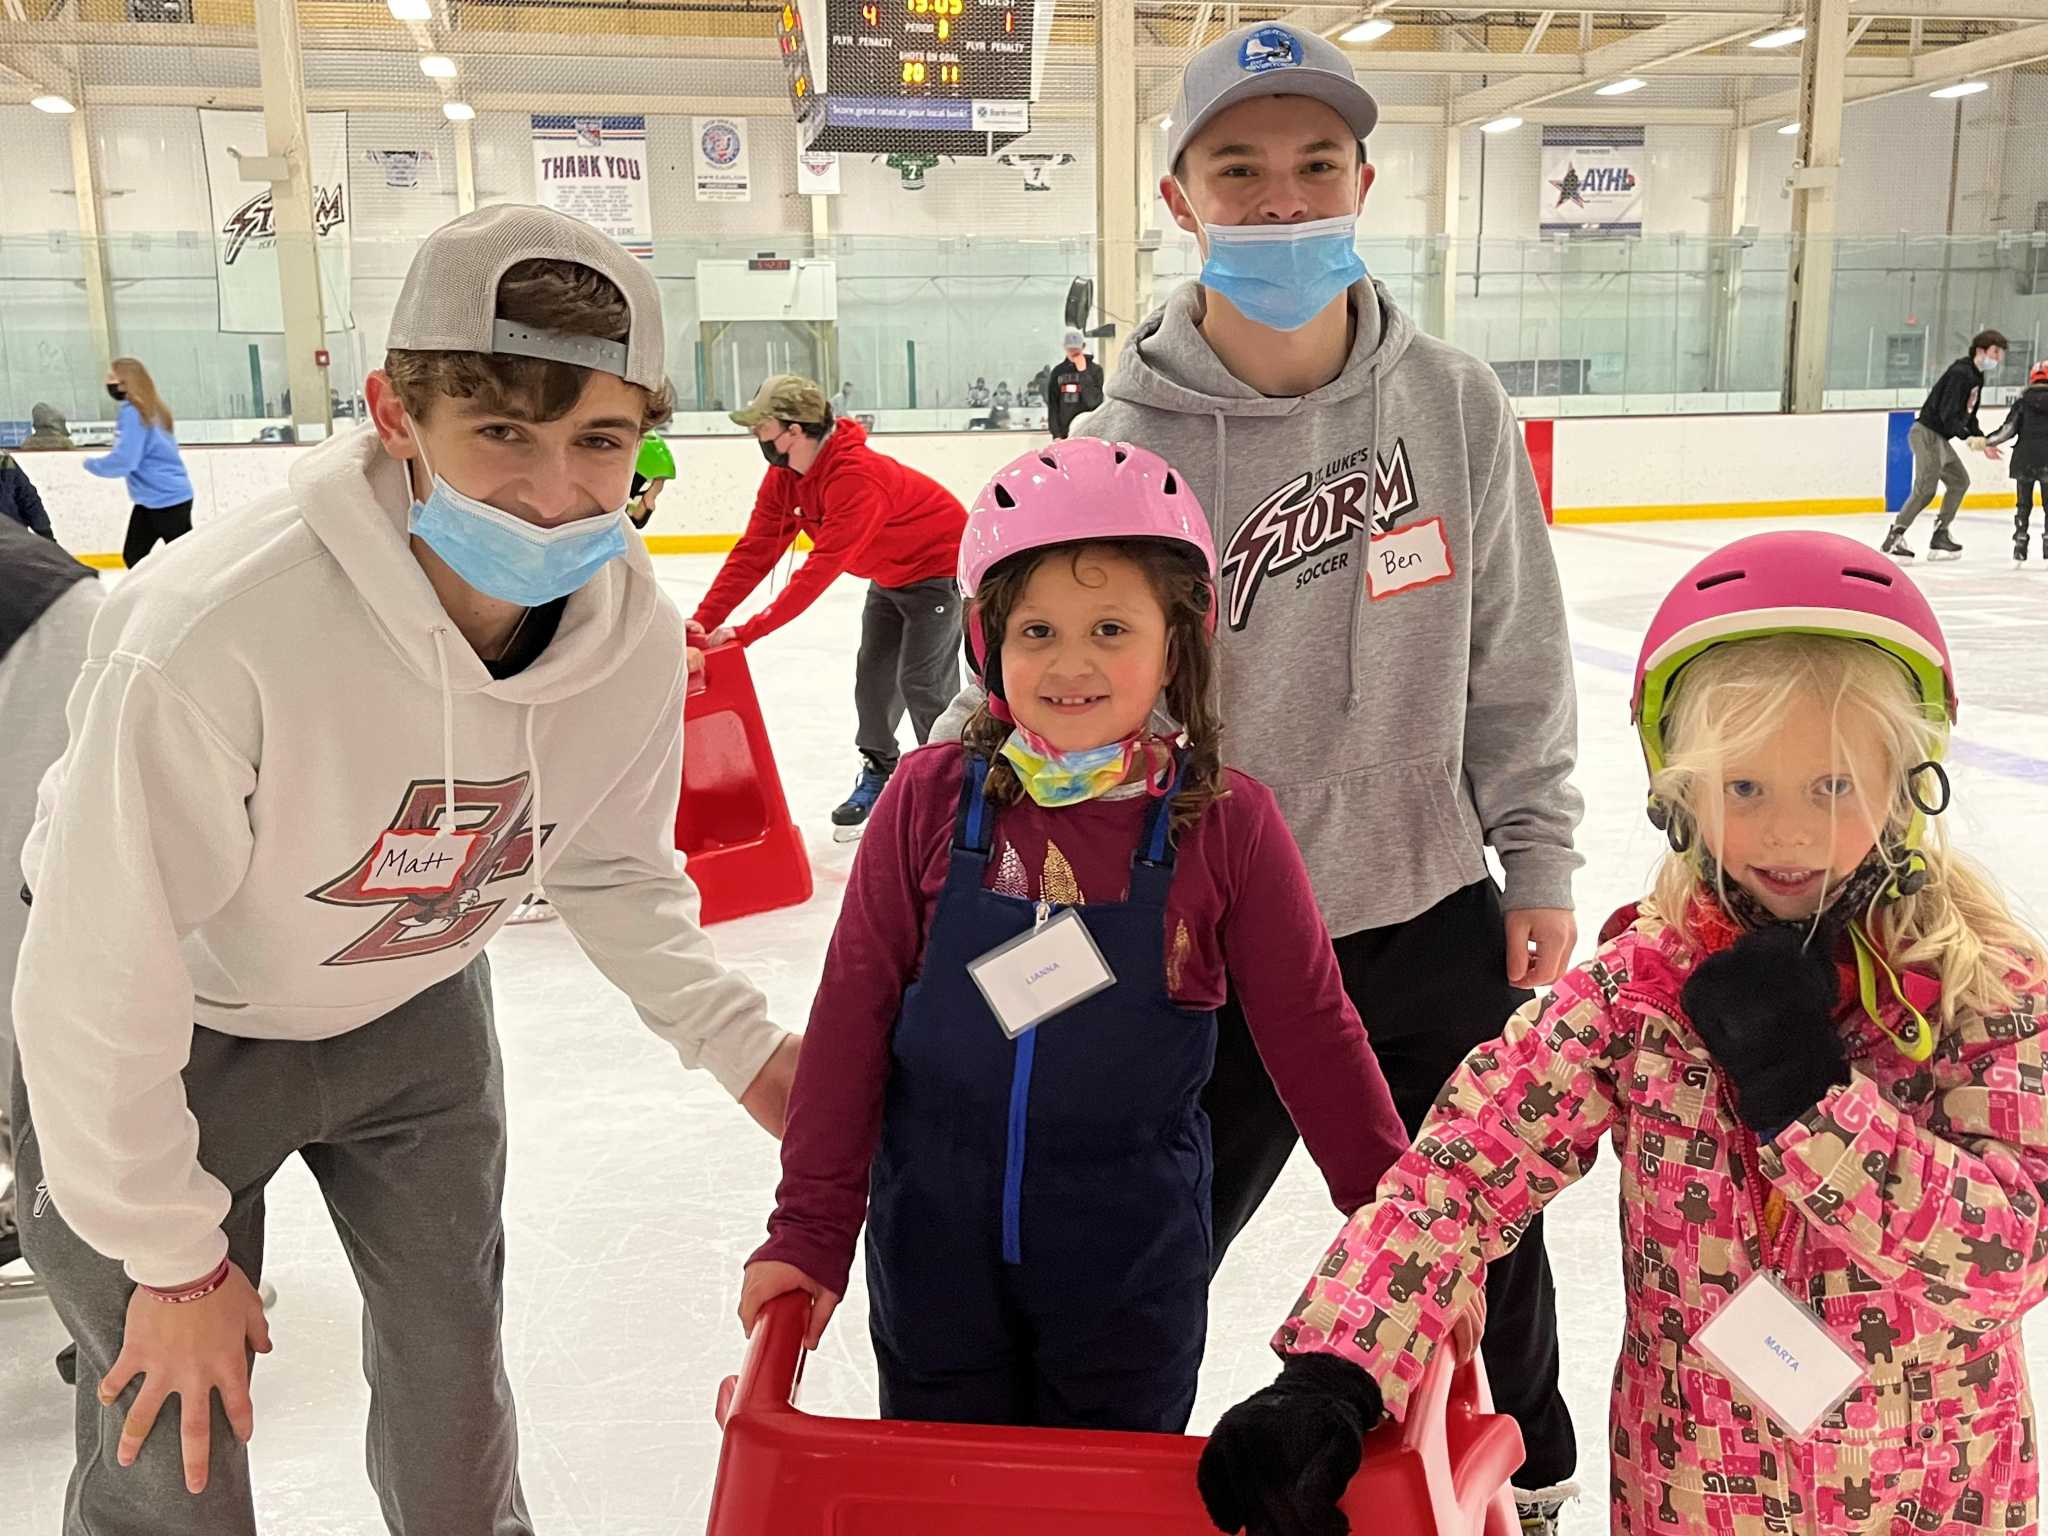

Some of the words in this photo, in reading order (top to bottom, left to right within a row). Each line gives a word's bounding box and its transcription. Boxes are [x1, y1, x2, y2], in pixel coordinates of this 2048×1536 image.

[862, 4, 877, 27] 4
[858, 36, 893, 48] PENALTY
[991, 43, 1024, 53] PENALTY
[541, 154, 602, 180] THANK
[605, 156, 641, 181] YOU
[1032, 167, 1041, 181] 7
[222, 183, 345, 265] STM
[1326, 447, 1369, 478] LUKE'S
[1222, 437, 1419, 632] STORM
[1296, 552, 1349, 589] SOCCER
[1380, 551, 1422, 575] Ben
[375, 849, 454, 878] Matt
[1025, 962, 1060, 985] LIANNA
[1763, 1335, 1800, 1372] MARTA
